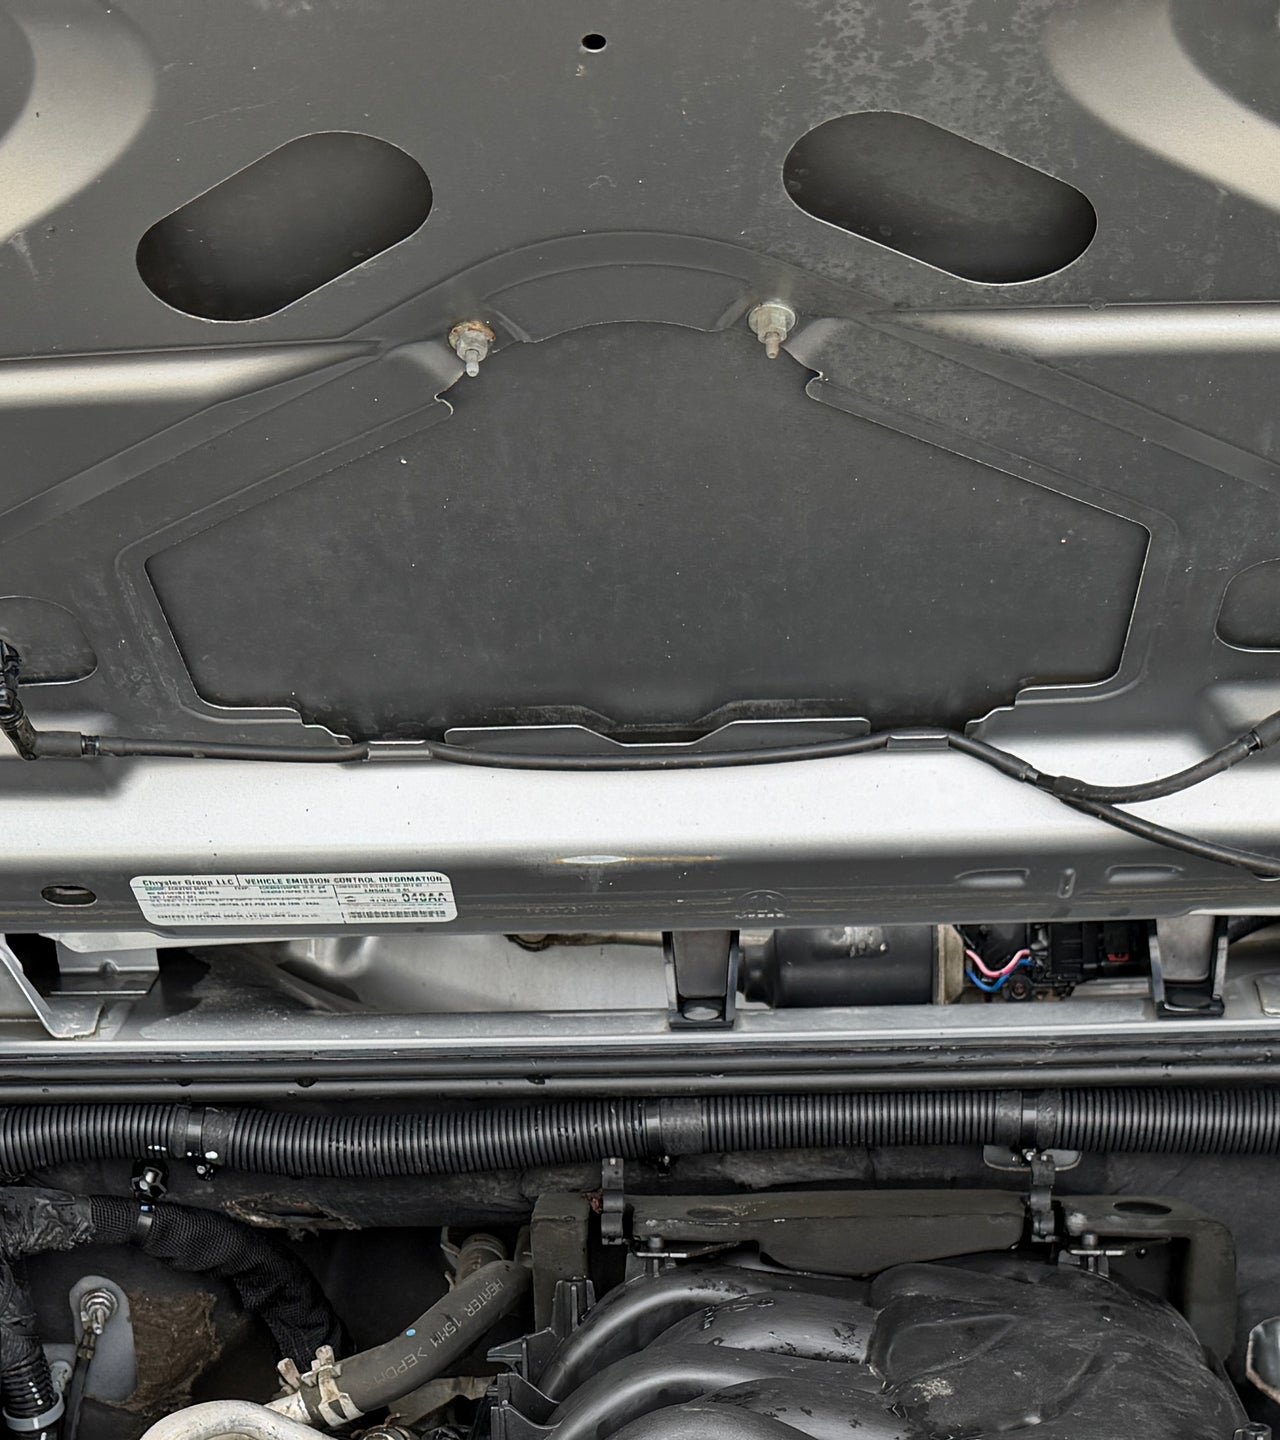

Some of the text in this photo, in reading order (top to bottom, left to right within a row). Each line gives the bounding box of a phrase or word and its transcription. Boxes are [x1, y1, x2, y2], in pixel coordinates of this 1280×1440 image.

[142, 879, 181, 888] Chrysler
[185, 879, 213, 887] Group
[464, 1279, 504, 1317] HEATER
[430, 1317, 462, 1348] 15MM
